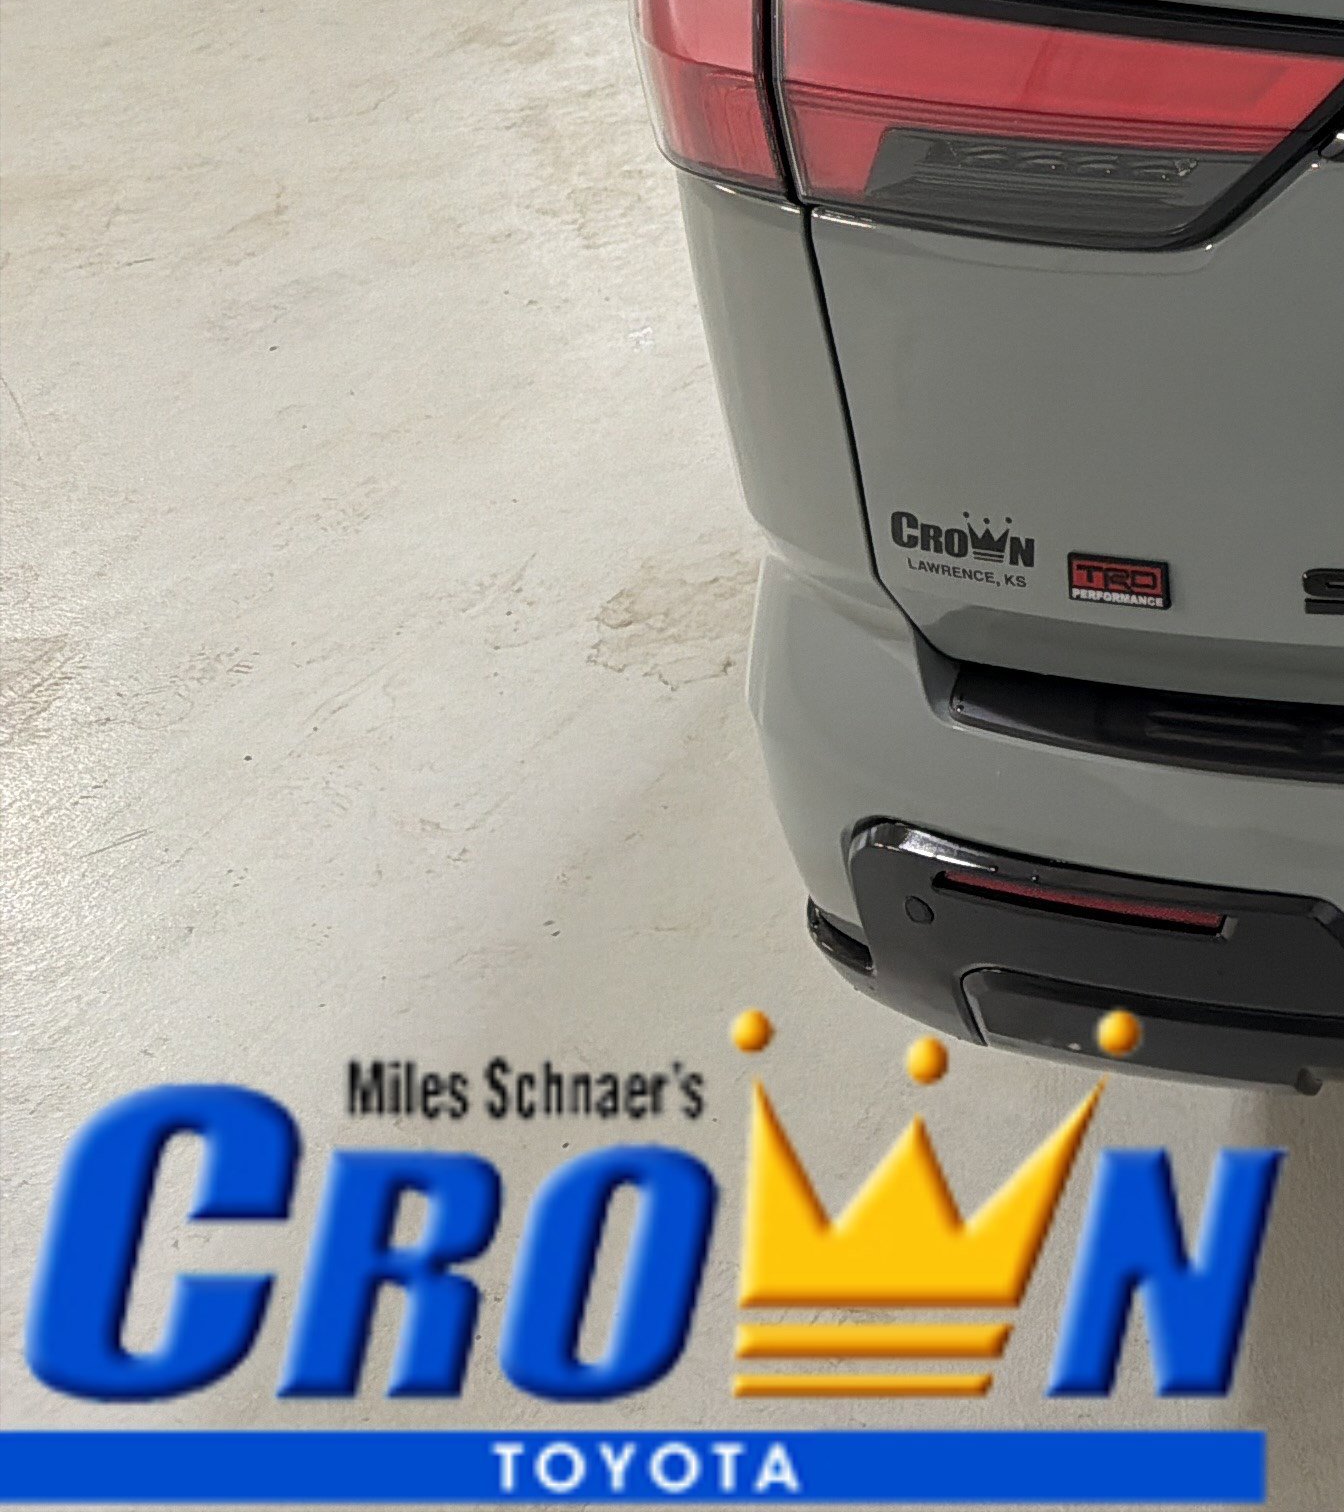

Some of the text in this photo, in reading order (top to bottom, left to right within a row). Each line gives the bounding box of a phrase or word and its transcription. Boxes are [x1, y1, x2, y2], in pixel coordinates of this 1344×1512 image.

[890, 511, 1035, 567] CROWN
[907, 558, 1027, 588] LAWRENCE, KS
[1076, 564, 1158, 590] TRD
[1072, 588, 1163, 607] PERFORMANCE
